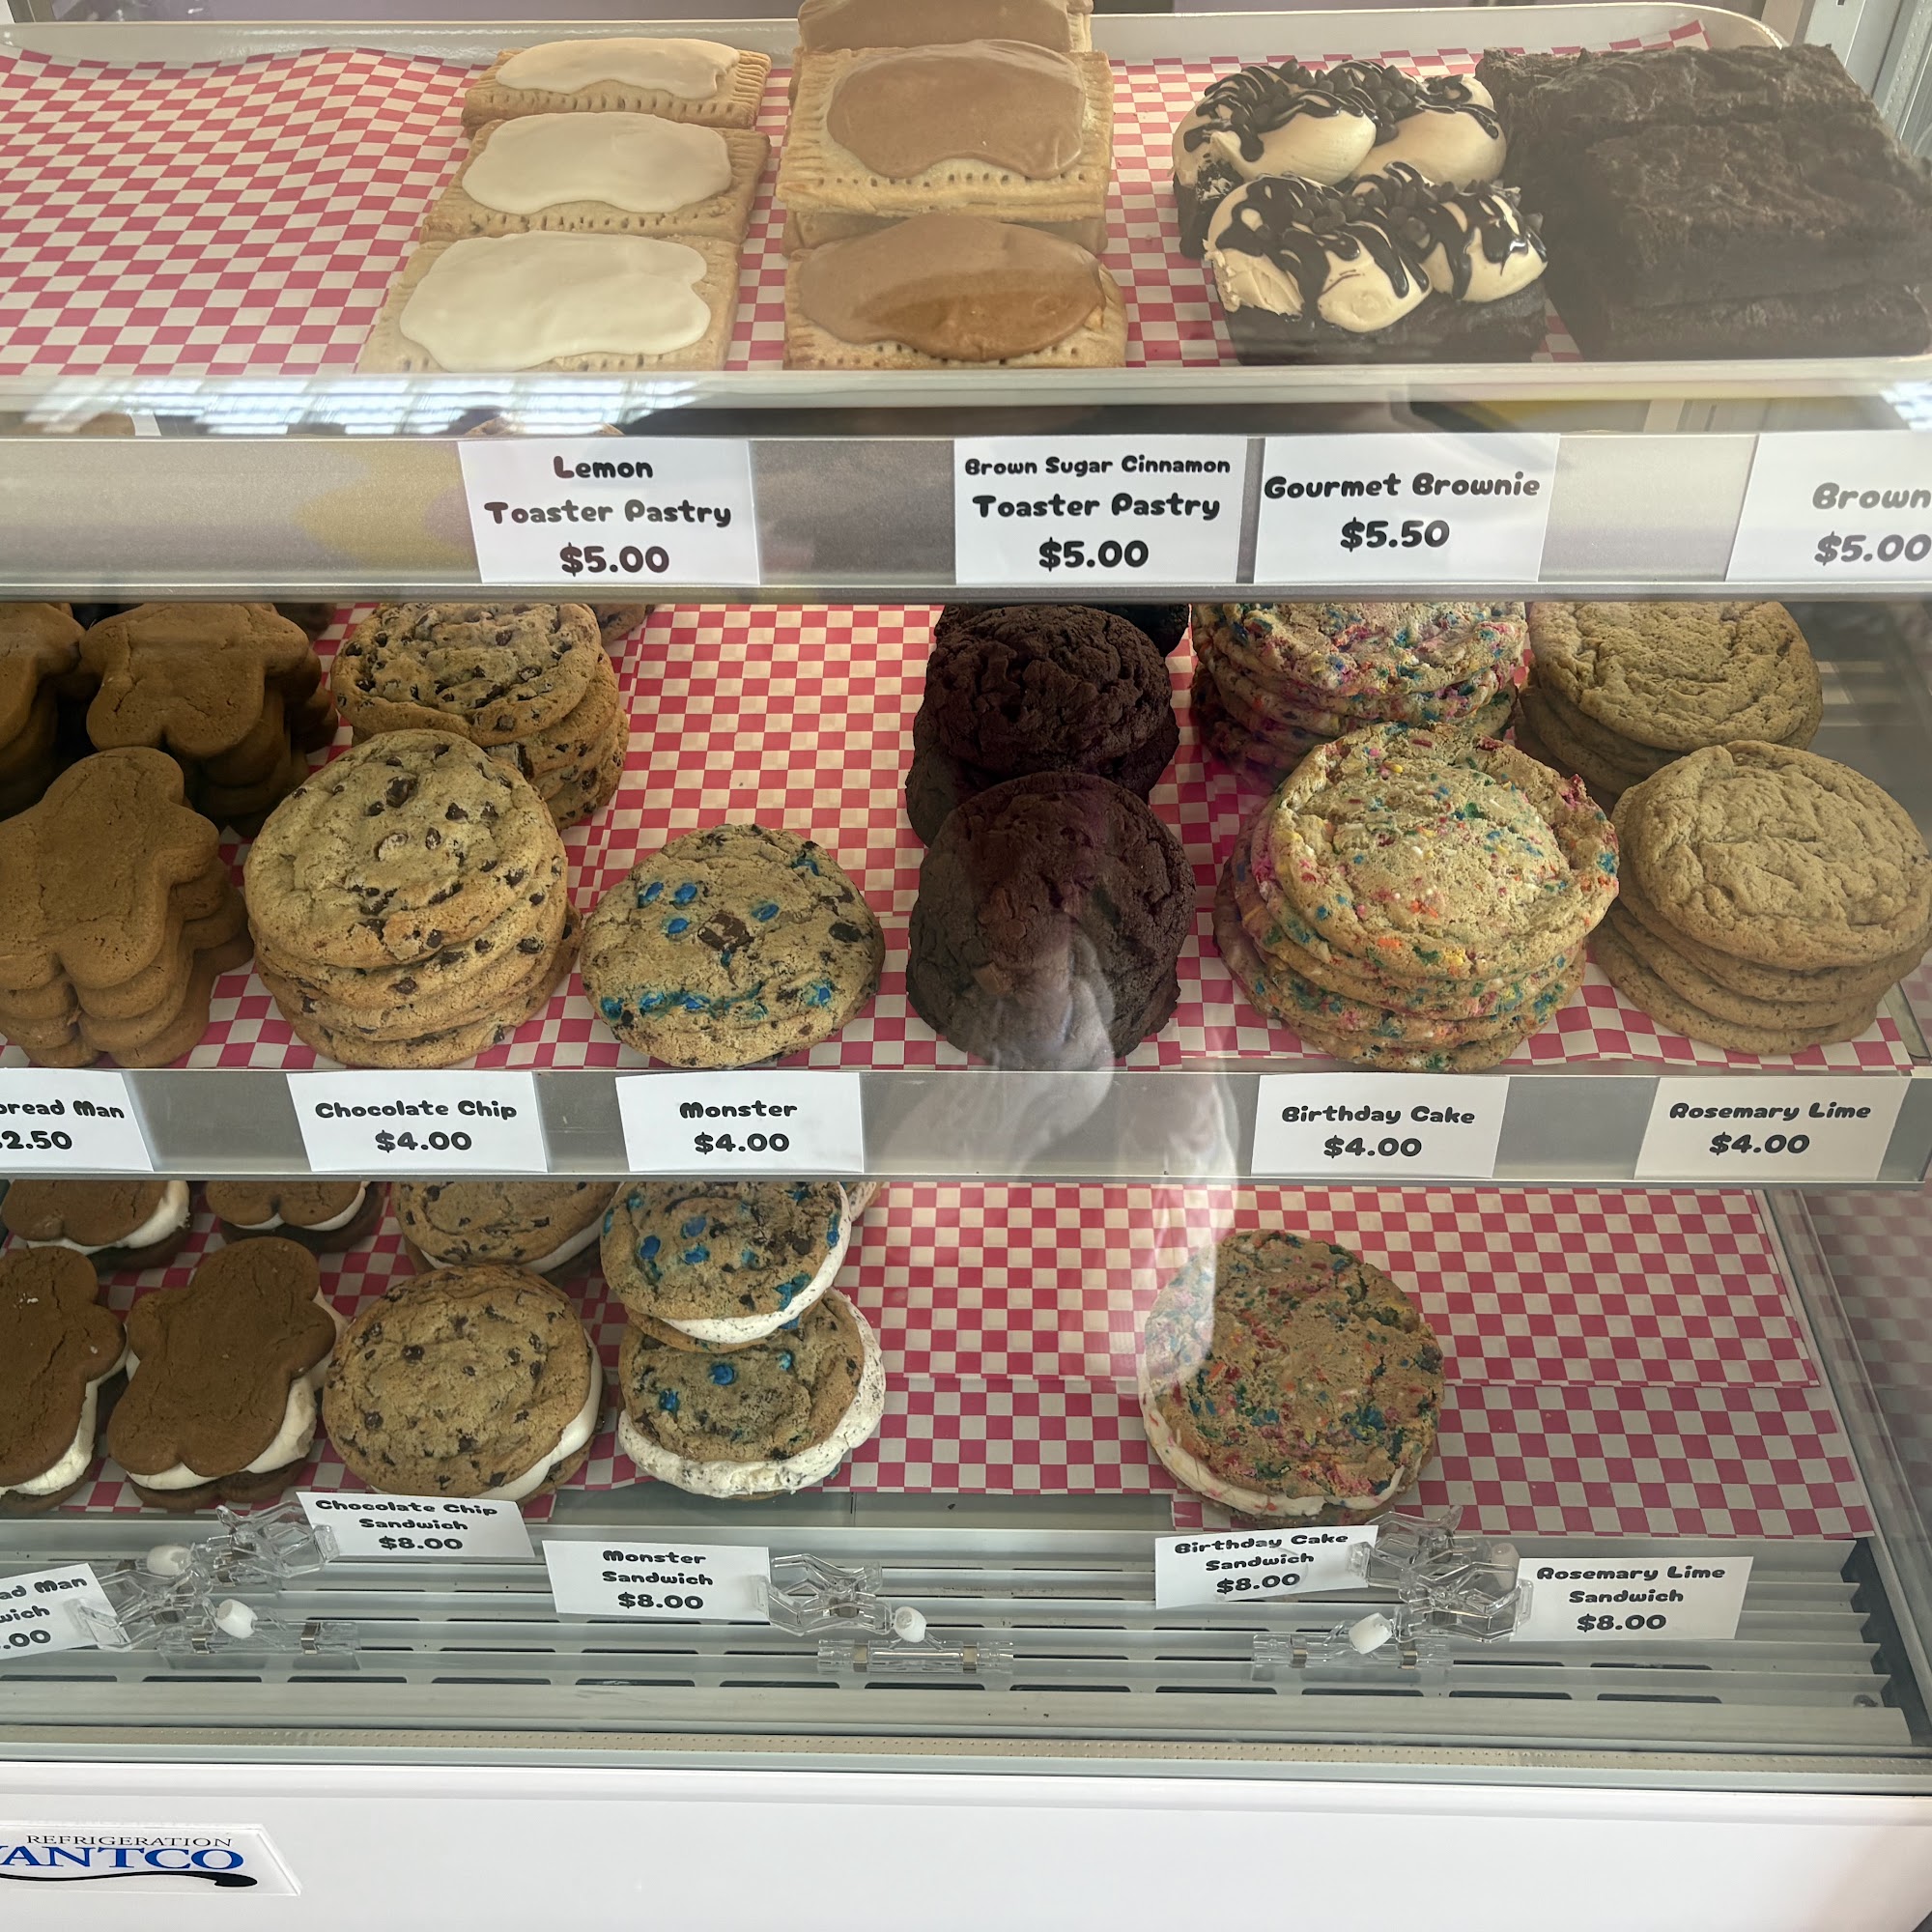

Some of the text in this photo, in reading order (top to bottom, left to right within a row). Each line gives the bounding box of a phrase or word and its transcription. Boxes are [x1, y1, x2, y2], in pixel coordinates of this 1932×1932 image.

[554, 456, 653, 478] Lemon
[965, 454, 1230, 477] Brown Sugar Cinnamon
[1264, 471, 1540, 498] Gourmet Brownie
[484, 499, 731, 527] Toaster Pastry
[973, 493, 1220, 521] Toaster Pastry
[1341, 517, 1449, 553] $5.50
[1039, 537, 1149, 572] $5.00
[1814, 531, 1932, 566] $5.00
[560, 542, 669, 577] $5.00
[73, 1100, 124, 1118] Man
[315, 1100, 517, 1120] Chocolate Chip
[680, 1100, 797, 1119] Monster
[1282, 1105, 1475, 1124] Birthday Cake
[1670, 1102, 1871, 1121] Rosemary Lime
[0, 1131, 71, 1150] 2.50
[375, 1129, 471, 1153] $4.00
[695, 1132, 789, 1154] $4.00
[1323, 1135, 1422, 1158] $4.00
[1710, 1132, 1809, 1155] $4.00
[316, 1500, 497, 1516] Chocolate Chip
[359, 1519, 468, 1529] Sandwich
[379, 1536, 463, 1550] $8.00
[1175, 1534, 1348, 1553] Birthday Cake
[603, 1550, 706, 1564] Monster
[1207, 1553, 1314, 1571] Sandwich
[603, 1571, 713, 1585] Sandwich
[1537, 1566, 1725, 1581] Rosemary Lime
[34, 1578, 87, 1593] Man
[1216, 1573, 1300, 1595] $8.00
[618, 1592, 703, 1609] $8.00
[1569, 1589, 1684, 1603] Sandwich
[1577, 1613, 1666, 1633] $8.00
[26, 1835, 232, 1847] REFRIGERATION
